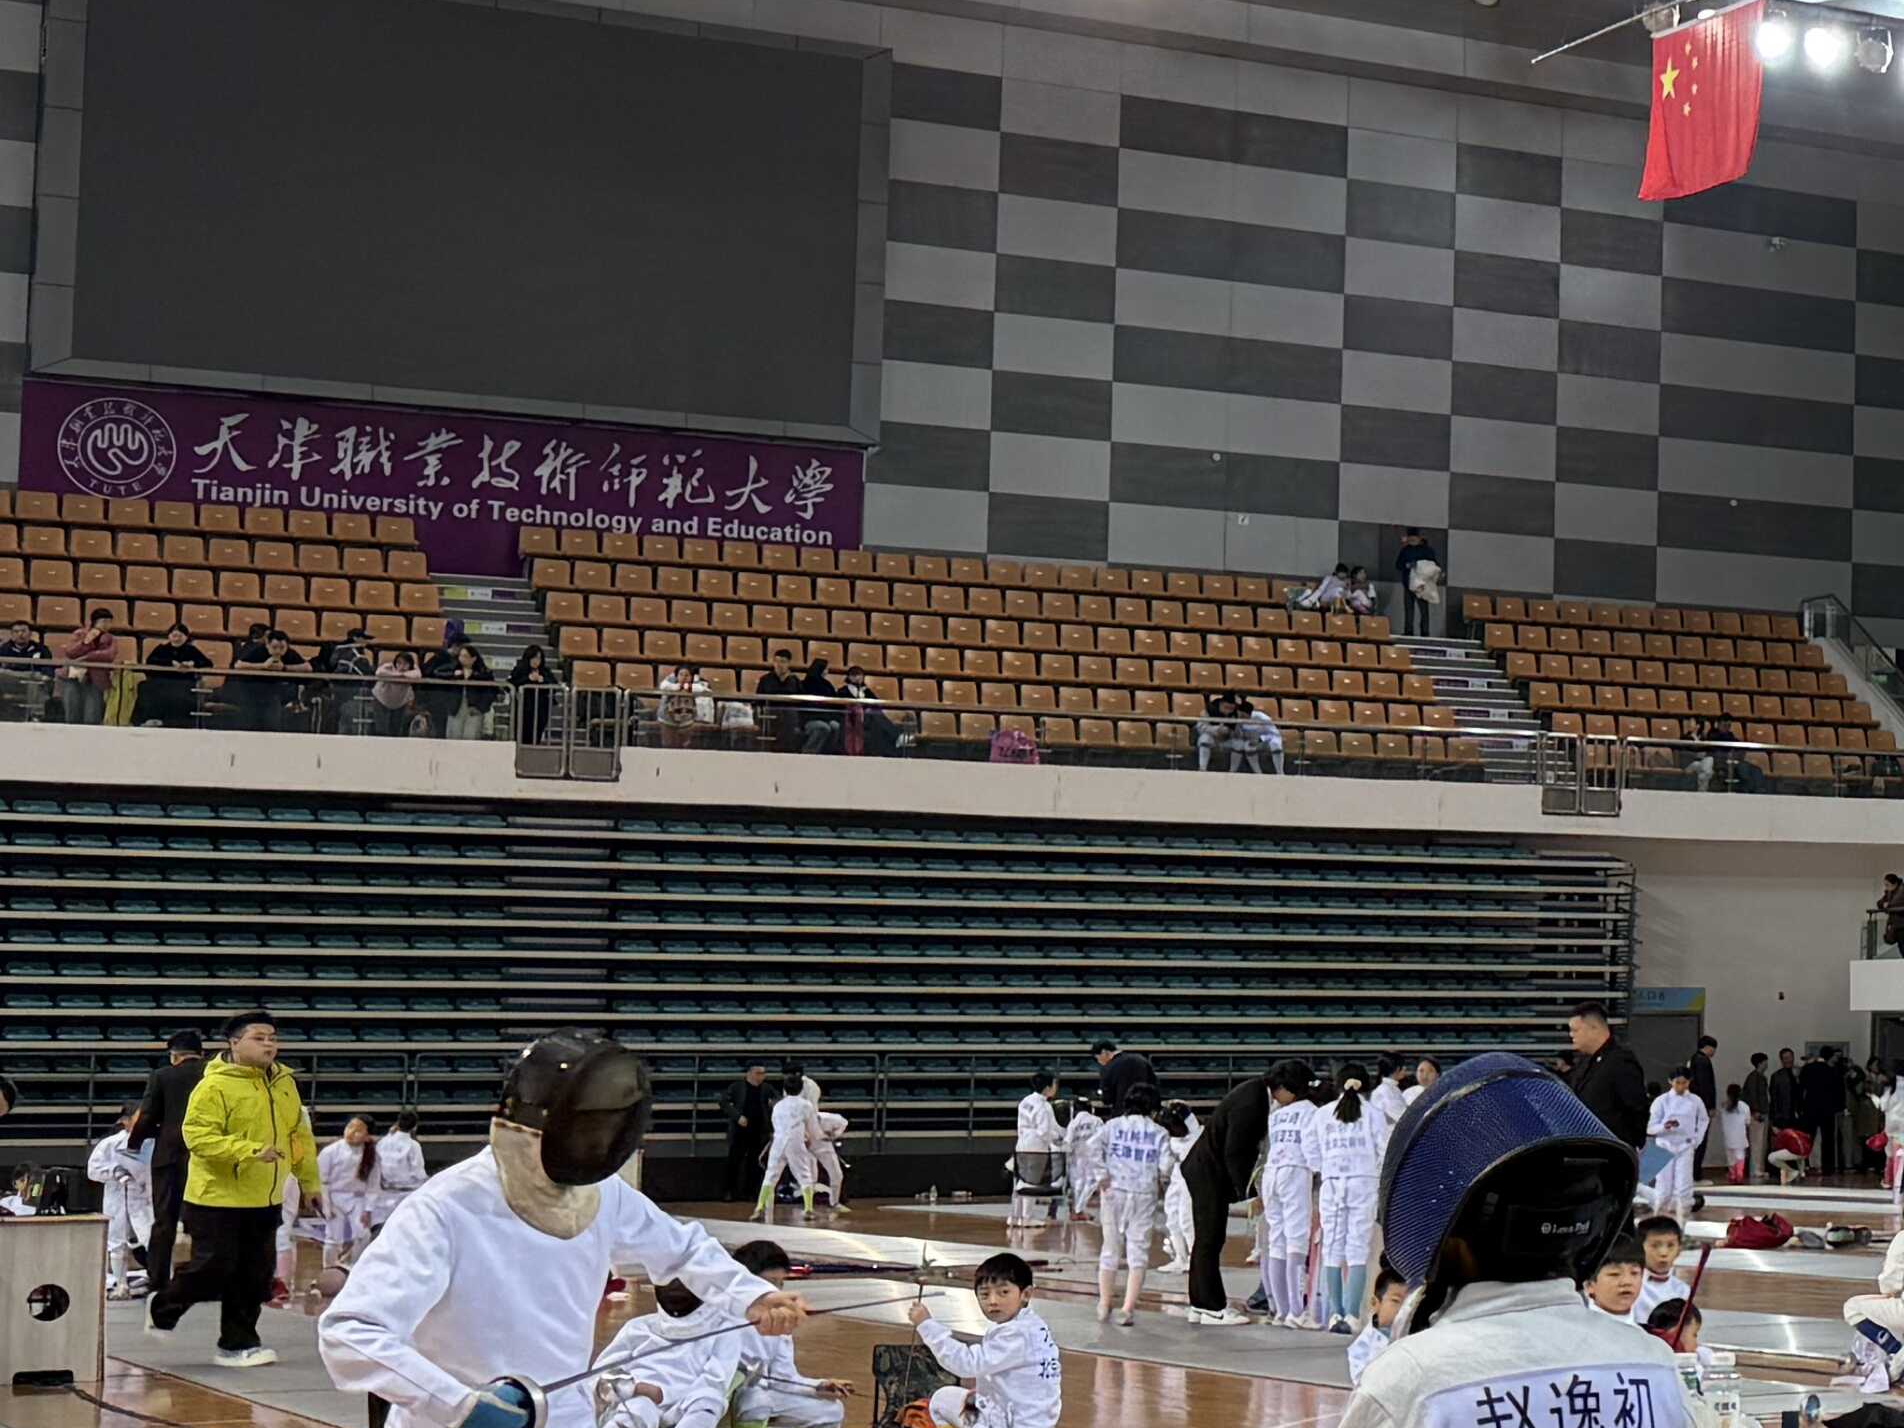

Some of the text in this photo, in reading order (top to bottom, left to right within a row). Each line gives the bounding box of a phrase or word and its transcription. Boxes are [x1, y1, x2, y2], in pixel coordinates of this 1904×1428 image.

[192, 477, 834, 546] Tianjin University of Technology and Education
